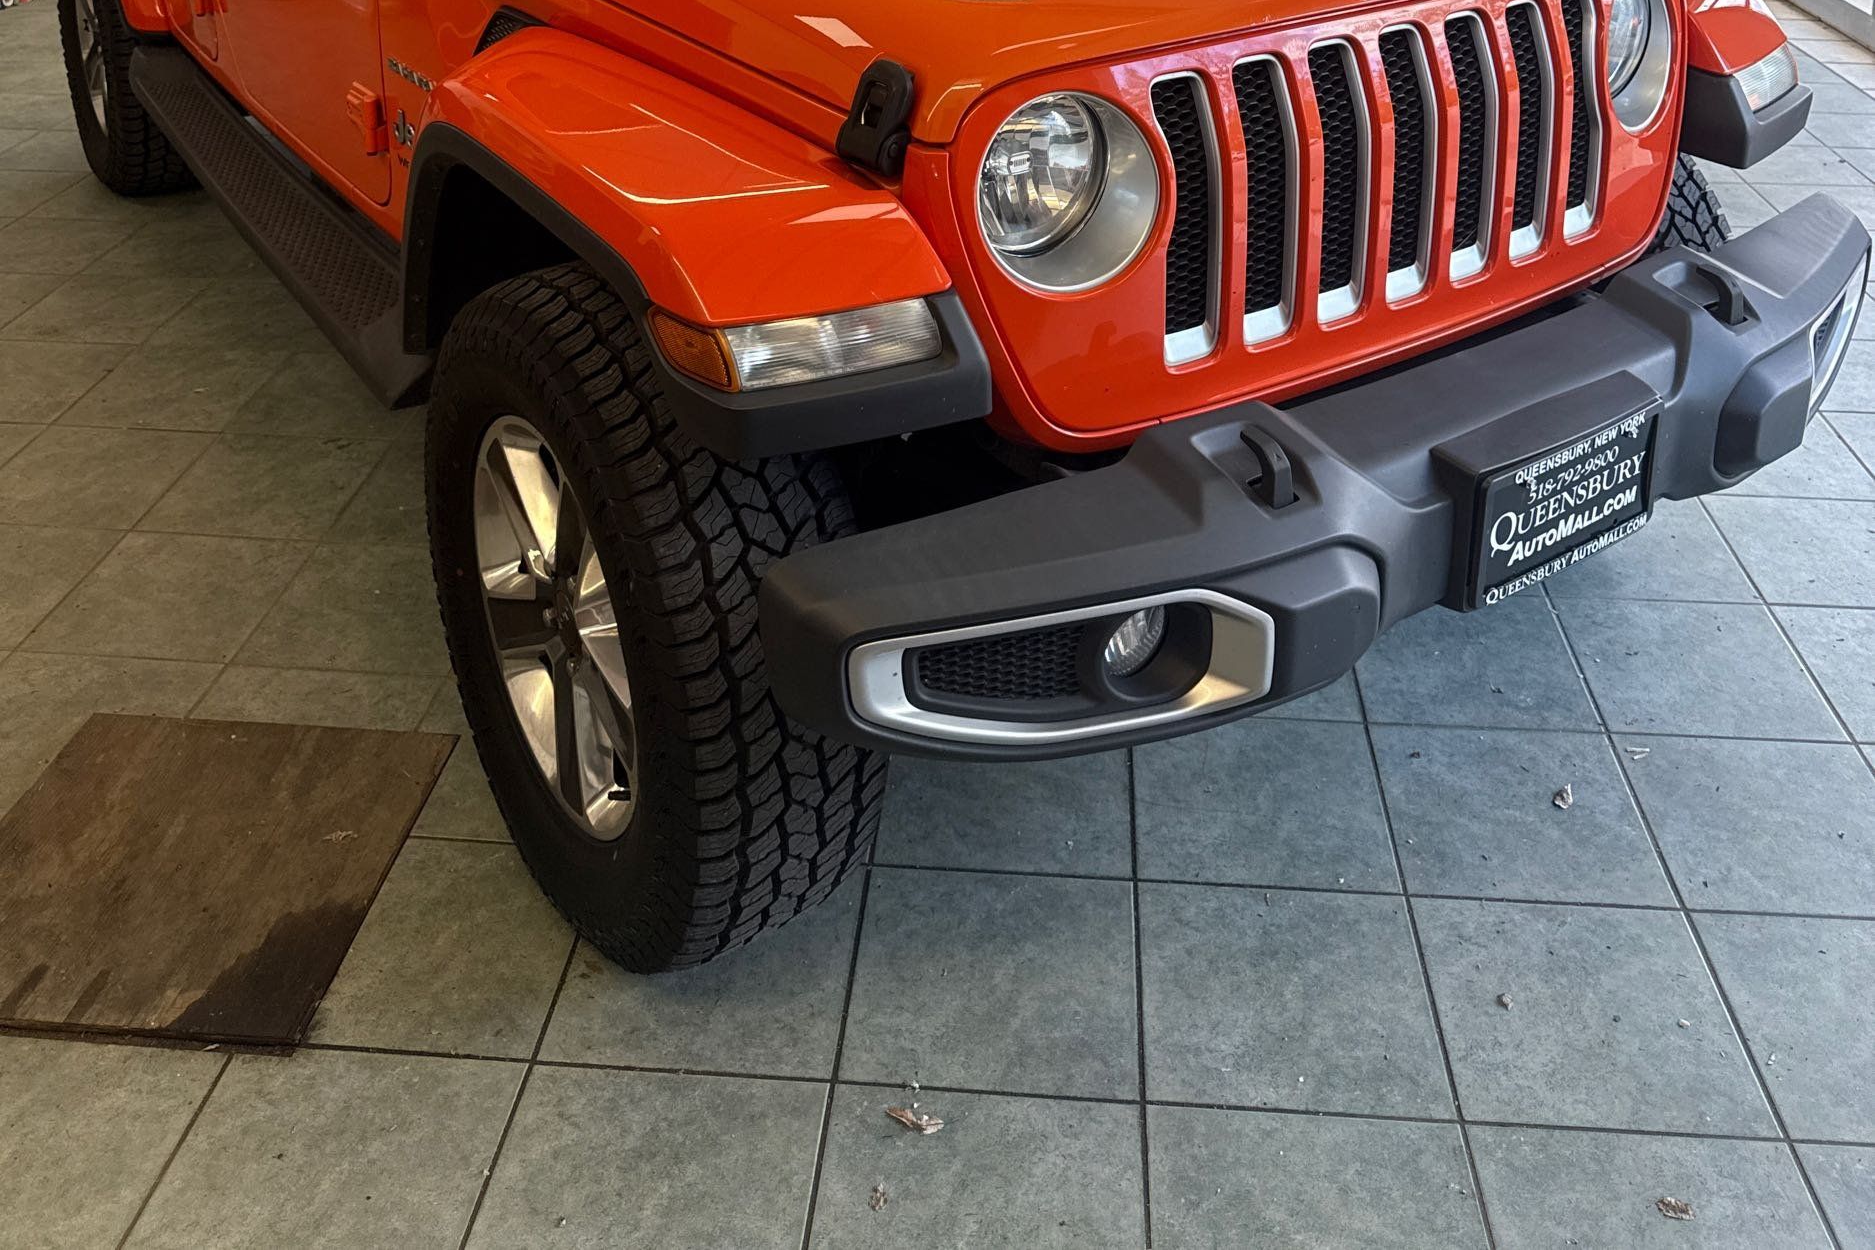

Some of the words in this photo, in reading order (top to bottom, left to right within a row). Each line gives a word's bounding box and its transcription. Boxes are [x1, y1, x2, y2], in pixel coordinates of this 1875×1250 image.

[1515, 439, 1592, 485] QUEENSBURY,
[1594, 427, 1619, 448] NEW
[1620, 412, 1646, 434] YORK
[1527, 445, 1620, 505] 518-792-9800
[1490, 451, 1647, 558] QUEENSBURY
[1485, 552, 1571, 607] QUEENSBURY
